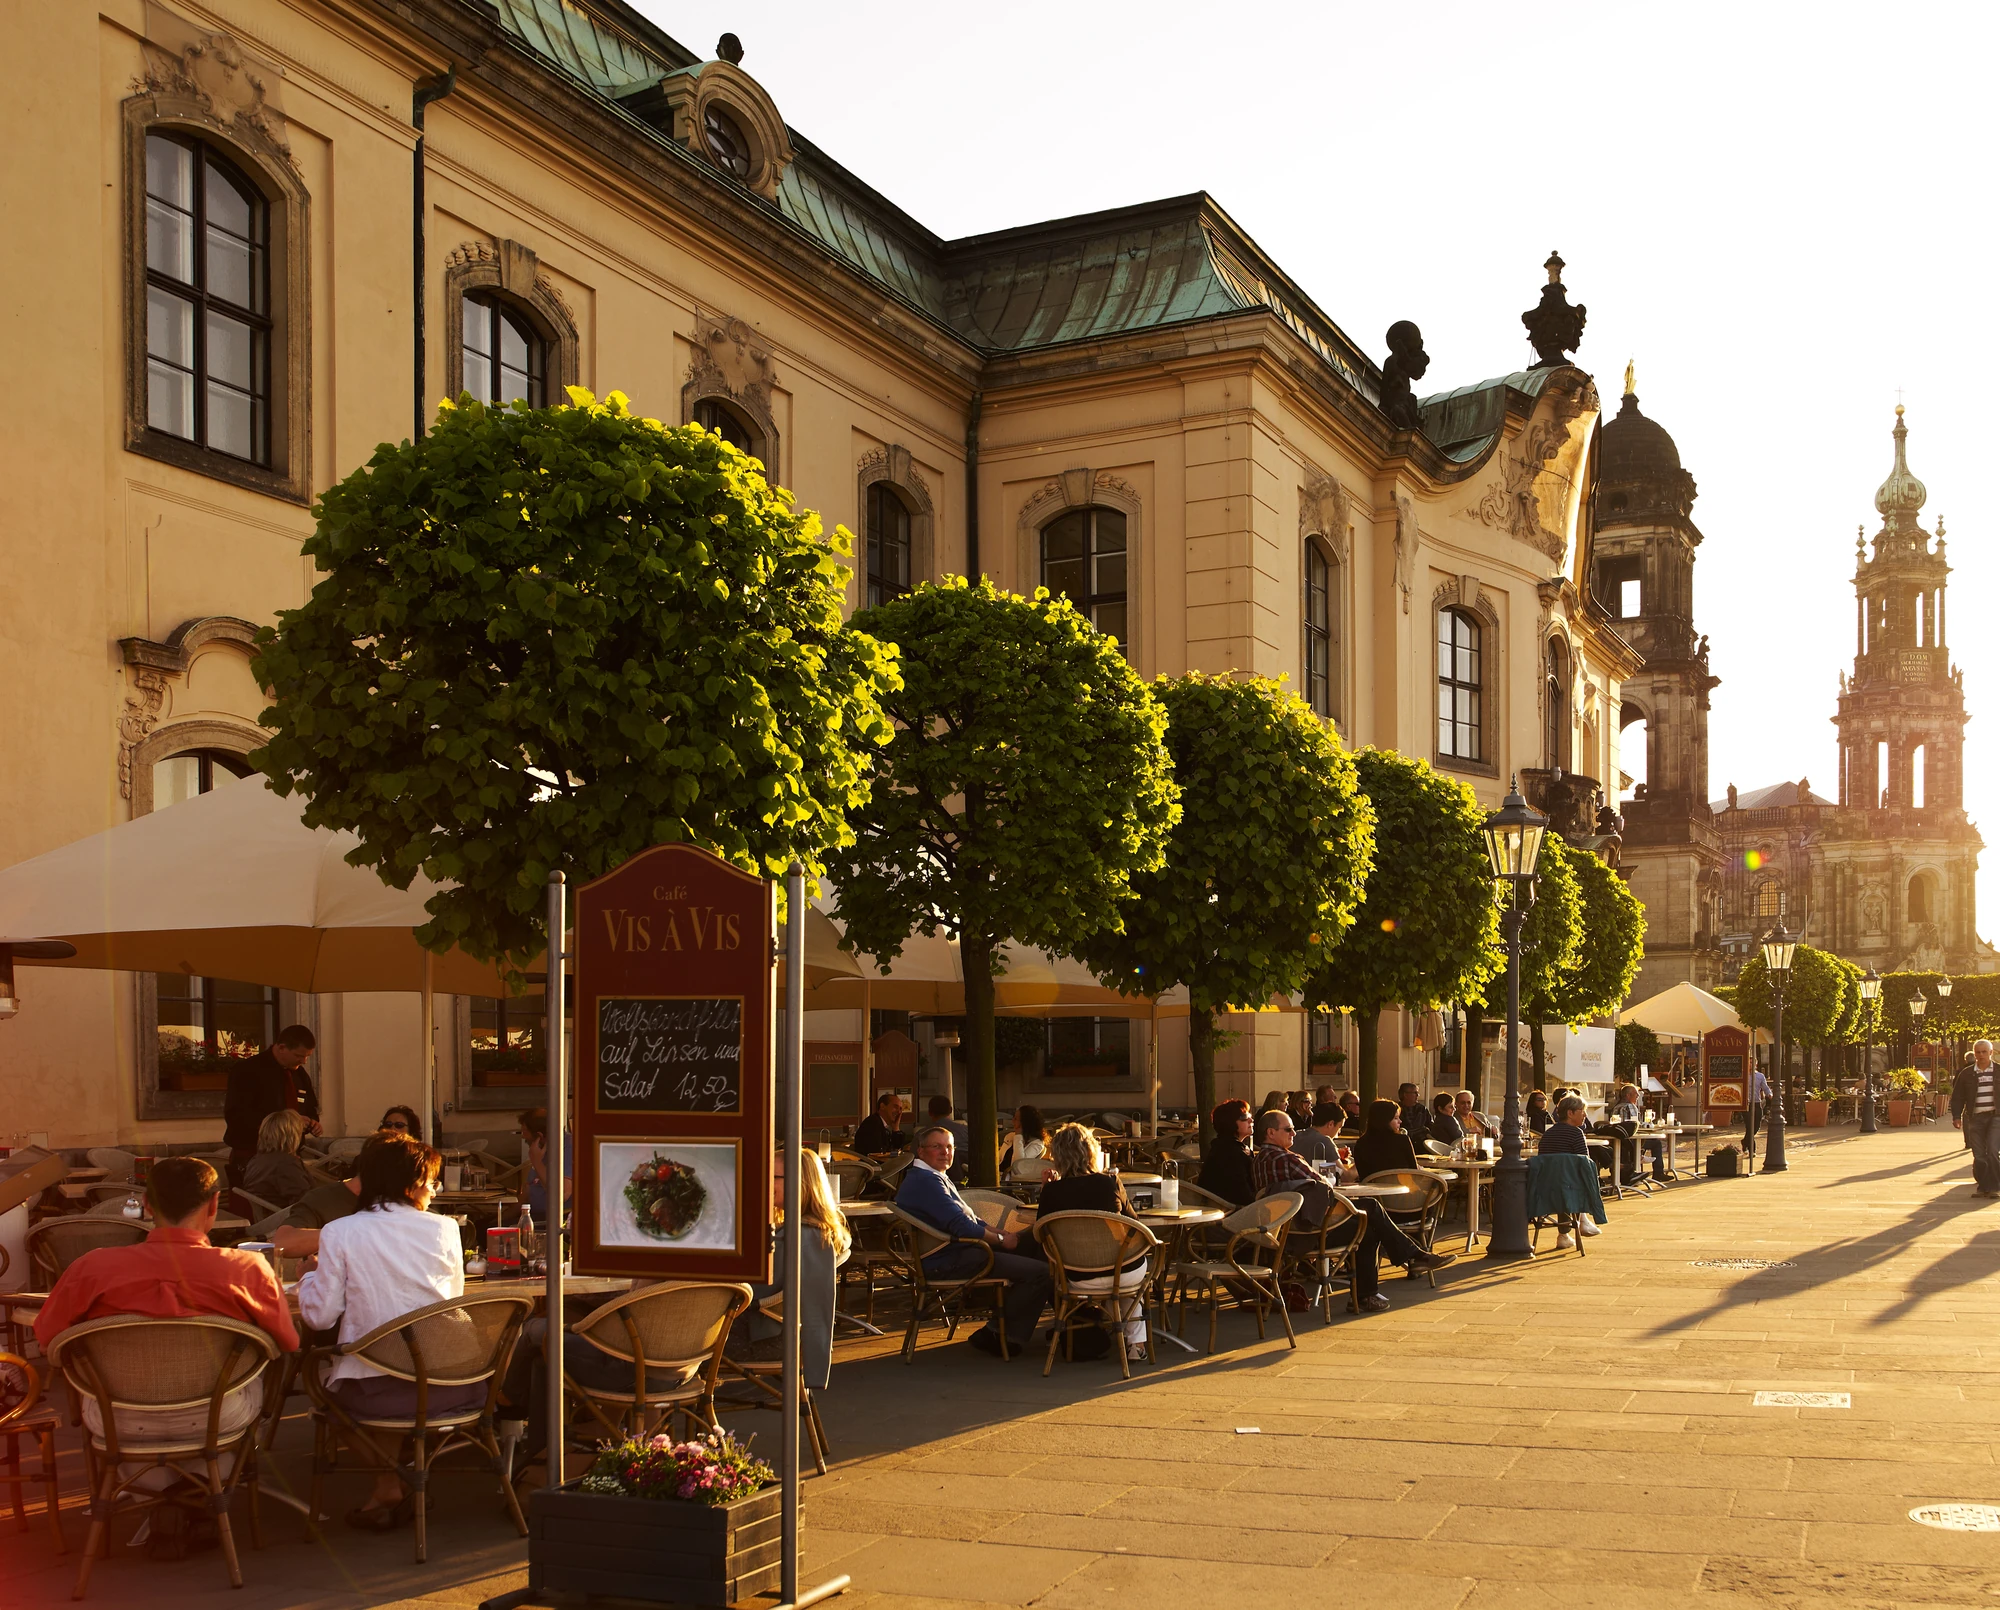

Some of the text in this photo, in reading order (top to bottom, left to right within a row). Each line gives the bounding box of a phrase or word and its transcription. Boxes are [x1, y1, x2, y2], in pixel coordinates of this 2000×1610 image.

[653, 885, 688, 901] Café
[601, 906, 740, 952] VIS À VIS
[600, 1035, 740, 1074] auf Linsen und
[604, 1067, 660, 1100] Salat
